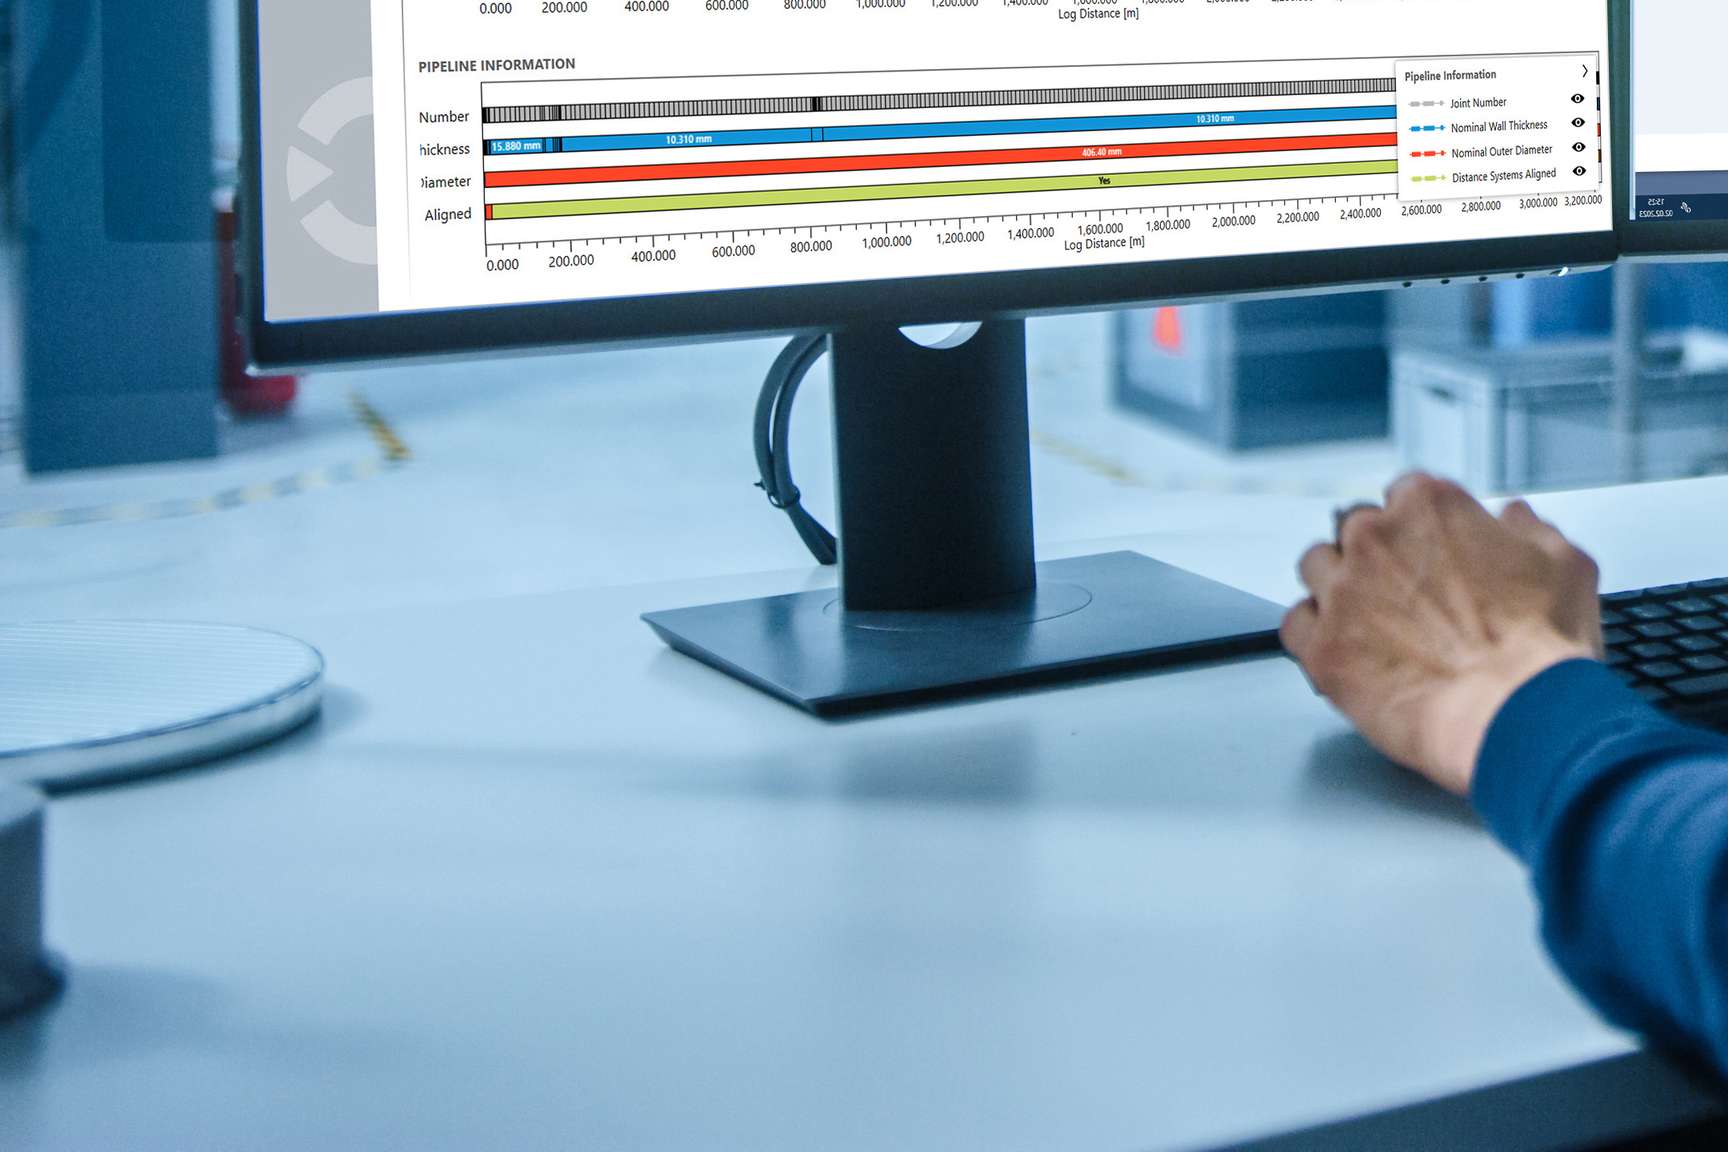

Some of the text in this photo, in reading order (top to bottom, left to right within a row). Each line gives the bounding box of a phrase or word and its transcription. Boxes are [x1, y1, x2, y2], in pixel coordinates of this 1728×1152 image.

[480, 3, 512, 14] 0.000
[625, 0, 669, 12] 400.000
[1059, 7, 1139, 22] Log Distance [m]
[419, 58, 576, 73] PIPELINE INFORMATION
[1405, 69, 1496, 83] Pipeline Information
[1450, 97, 1507, 109] Joint Number
[419, 111, 469, 123] Number
[1196, 115, 1219, 123] 10.310
[1451, 120, 1548, 133] Nominal Wall Thickness
[492, 141, 541, 152] 15.880 mm
[667, 135, 694, 145] 10.310
[1108, 148, 1122, 156] mm
[1452, 145, 1552, 158] Nominal Outer Diameter
[1098, 176, 1111, 186] Yes
[1452, 168, 1556, 183] Distance Systems Aligned
[425, 208, 471, 224] Aligned
[486, 195, 1602, 271] 0.000 400.000 800.000 1,200.000 1,600.000 2,000.000 2,400.000 2,800.000 3,200.000
[1064, 236, 1145, 252] Log Distance [m]
